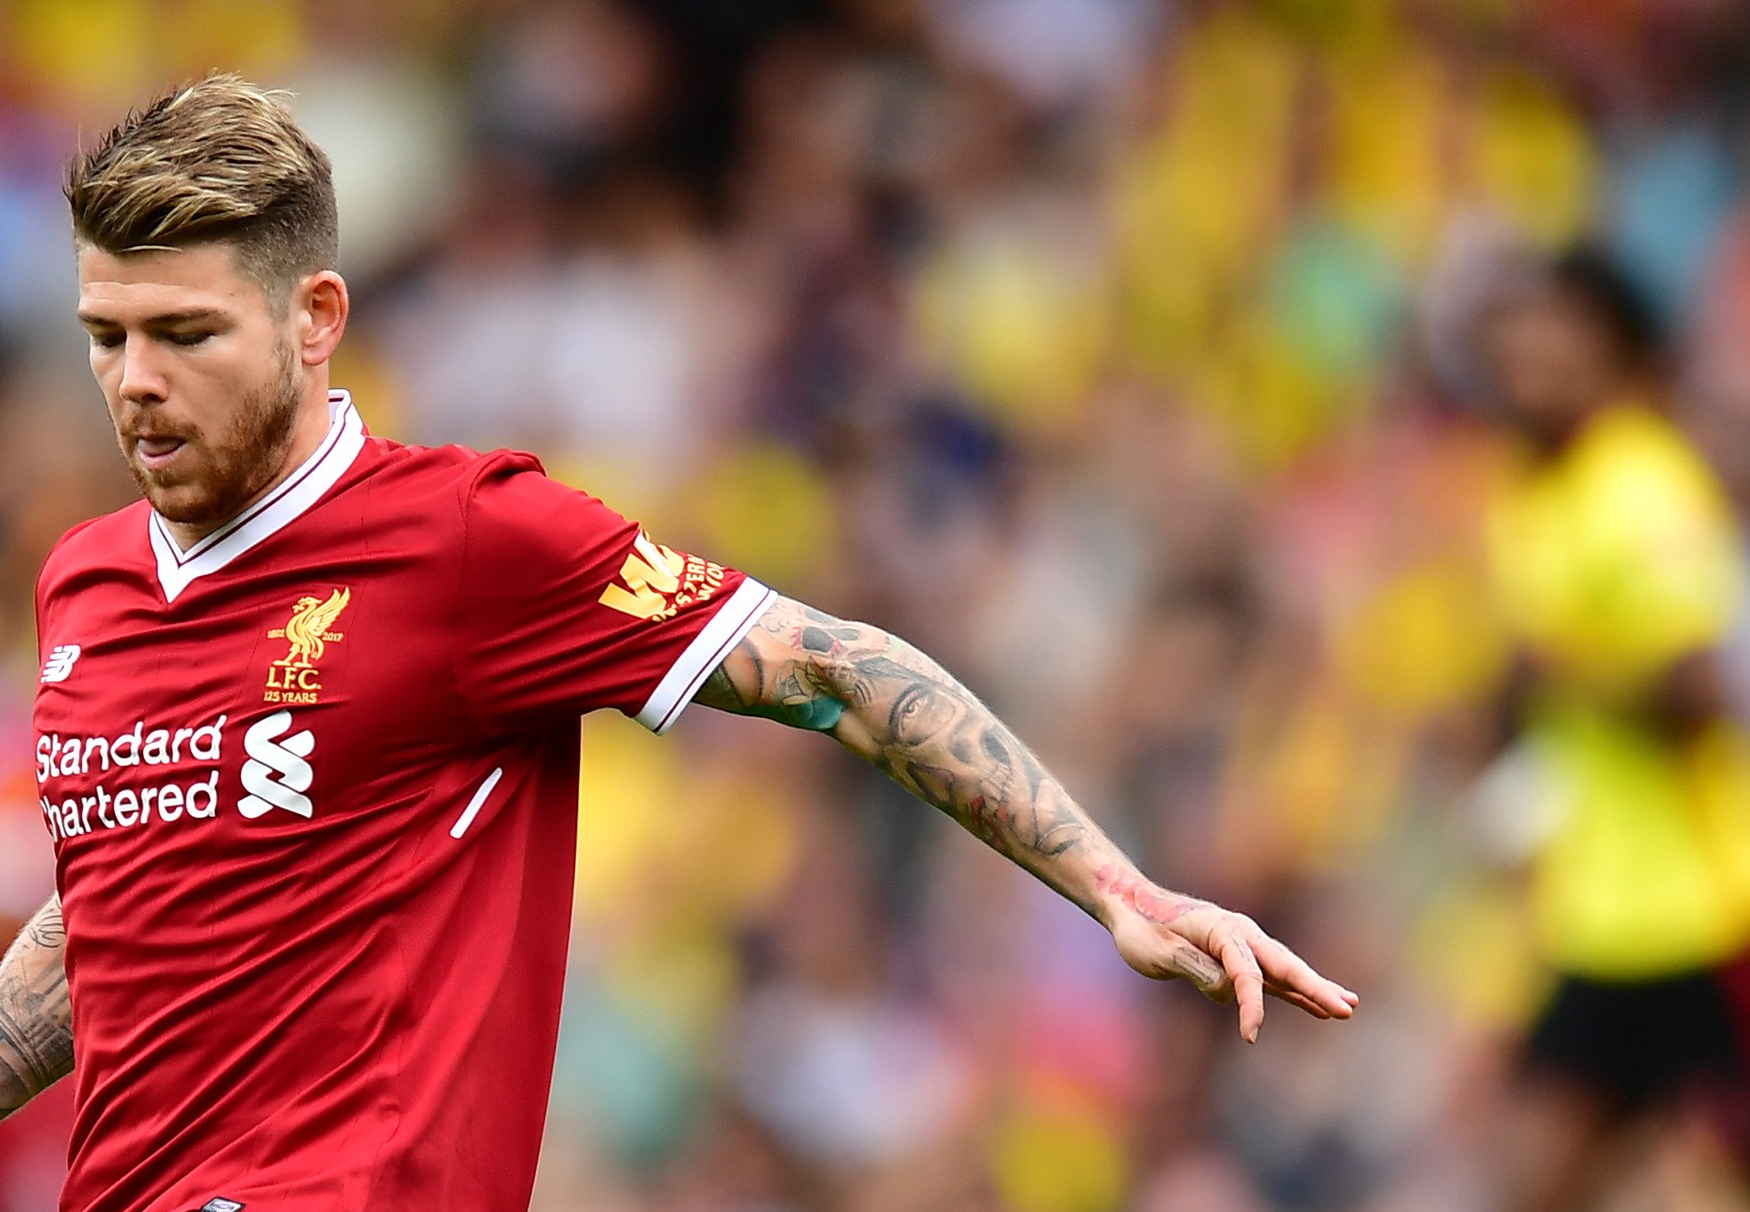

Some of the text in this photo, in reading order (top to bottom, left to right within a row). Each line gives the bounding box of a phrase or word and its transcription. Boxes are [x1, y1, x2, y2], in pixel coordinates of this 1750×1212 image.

[322, 632, 344, 642] 2017
[264, 691, 318, 704] 125 YEARS
[36, 714, 227, 783] Standard
